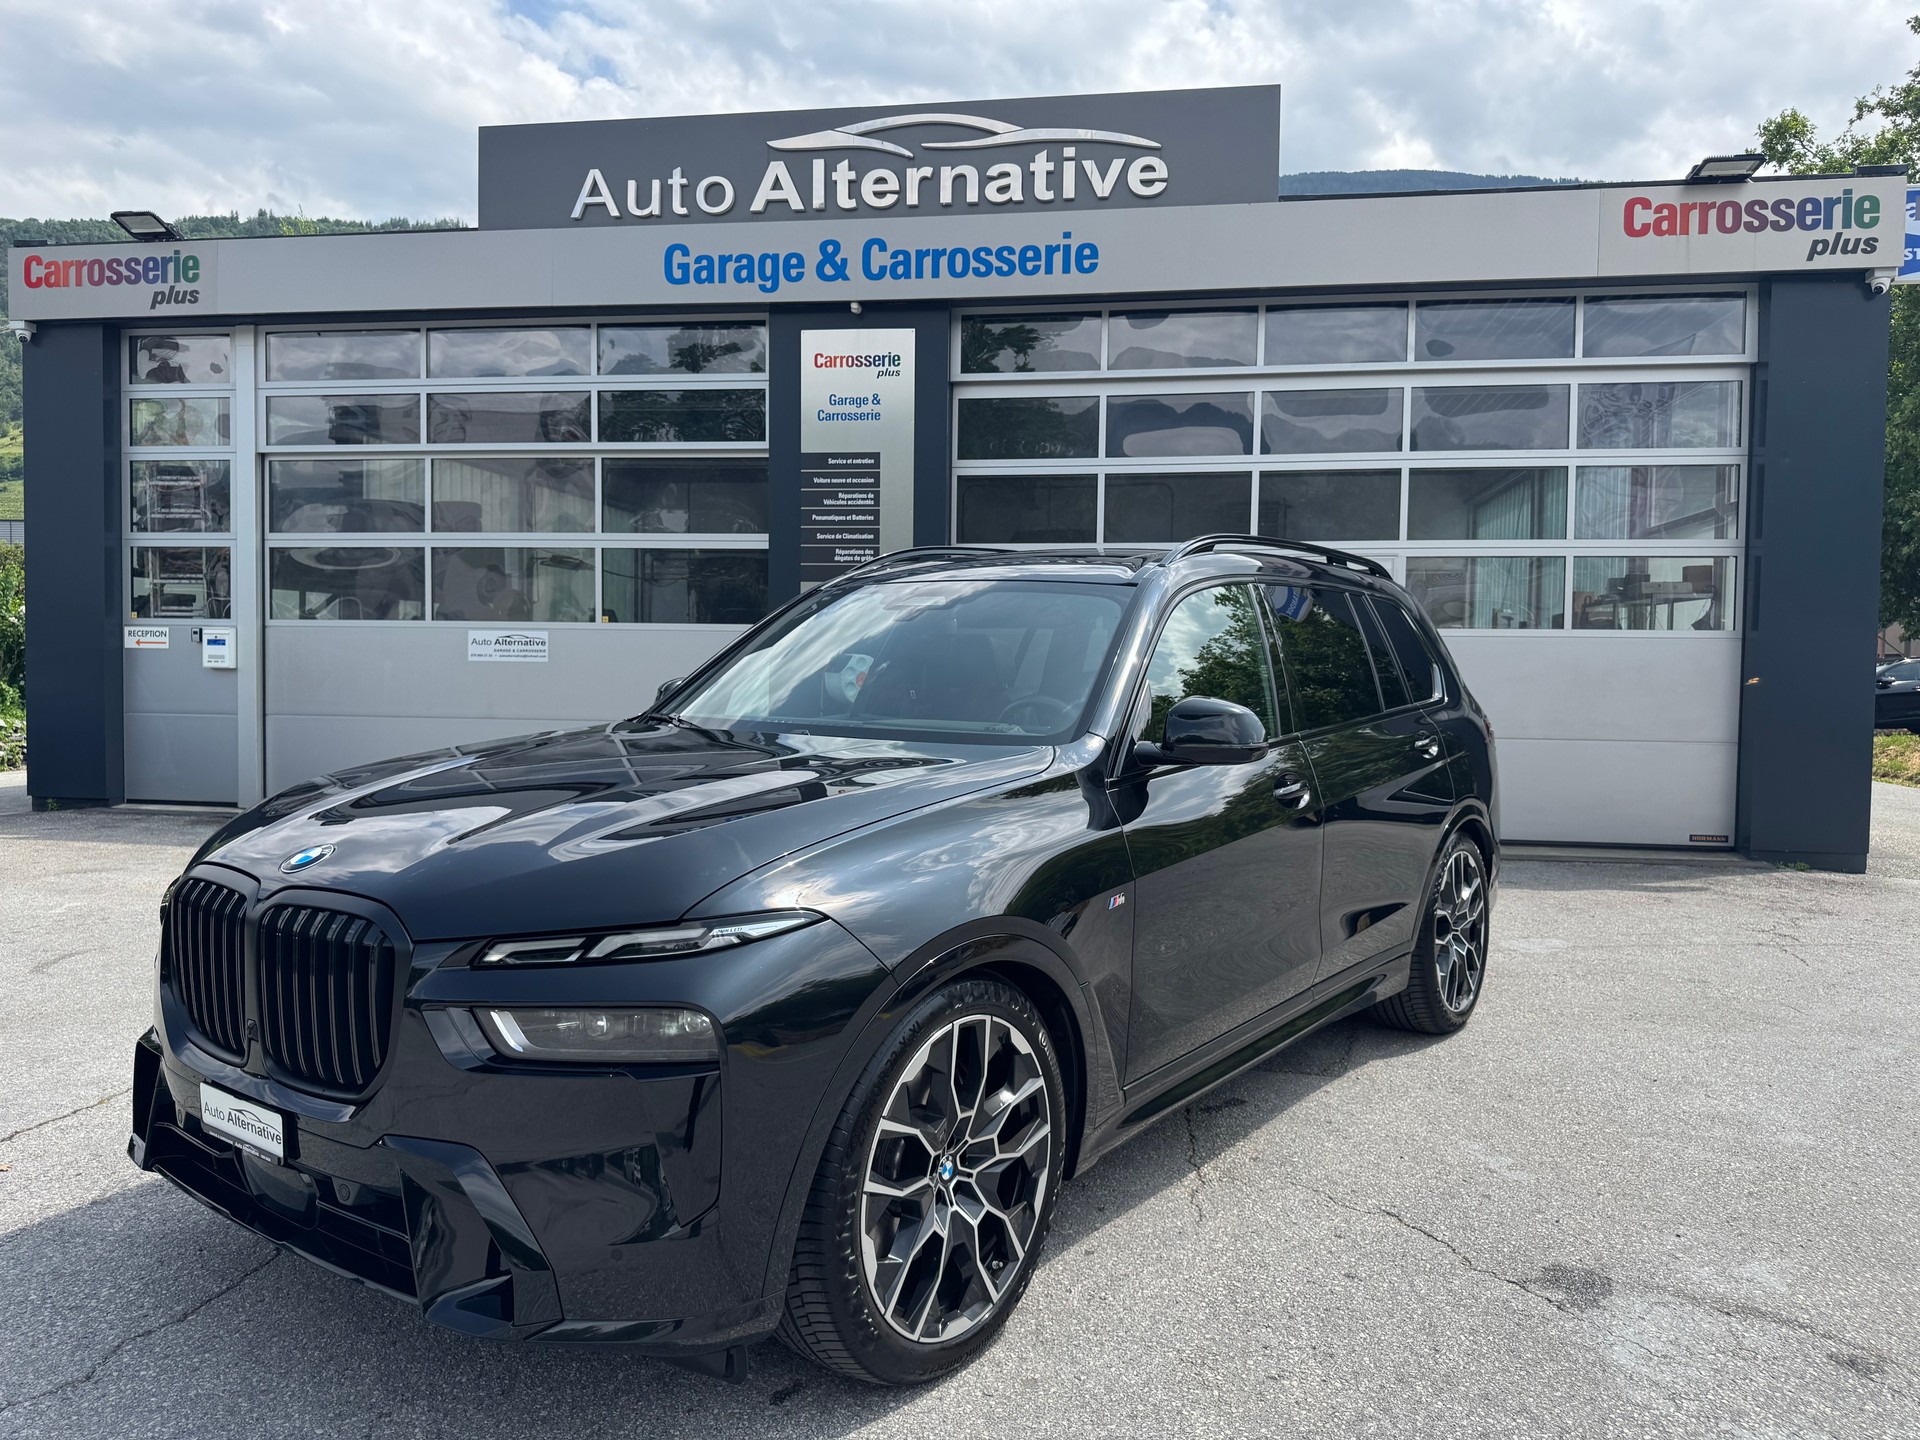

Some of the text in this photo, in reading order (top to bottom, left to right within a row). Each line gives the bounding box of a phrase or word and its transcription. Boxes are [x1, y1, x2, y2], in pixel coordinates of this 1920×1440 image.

[570, 147, 1168, 219] Auto Alternative
[1623, 189, 1880, 237] Carrosserie
[1806, 232, 1878, 261] plus
[23, 250, 200, 289] Carrosserie
[664, 231, 1099, 293] Garage & Carrosserie
[150, 285, 200, 310] plus
[814, 352, 901, 368] Carrosserie
[877, 368, 901, 379] plus
[829, 393, 881, 408] Garage &
[817, 409, 881, 421] Carrosserie
[812, 514, 846, 522] Pneumatiques
[128, 630, 167, 638] RECEPTION
[471, 638, 547, 647] Auto Alternative
[204, 1102, 225, 1121] Auto
[227, 1111, 282, 1145] Alternative
